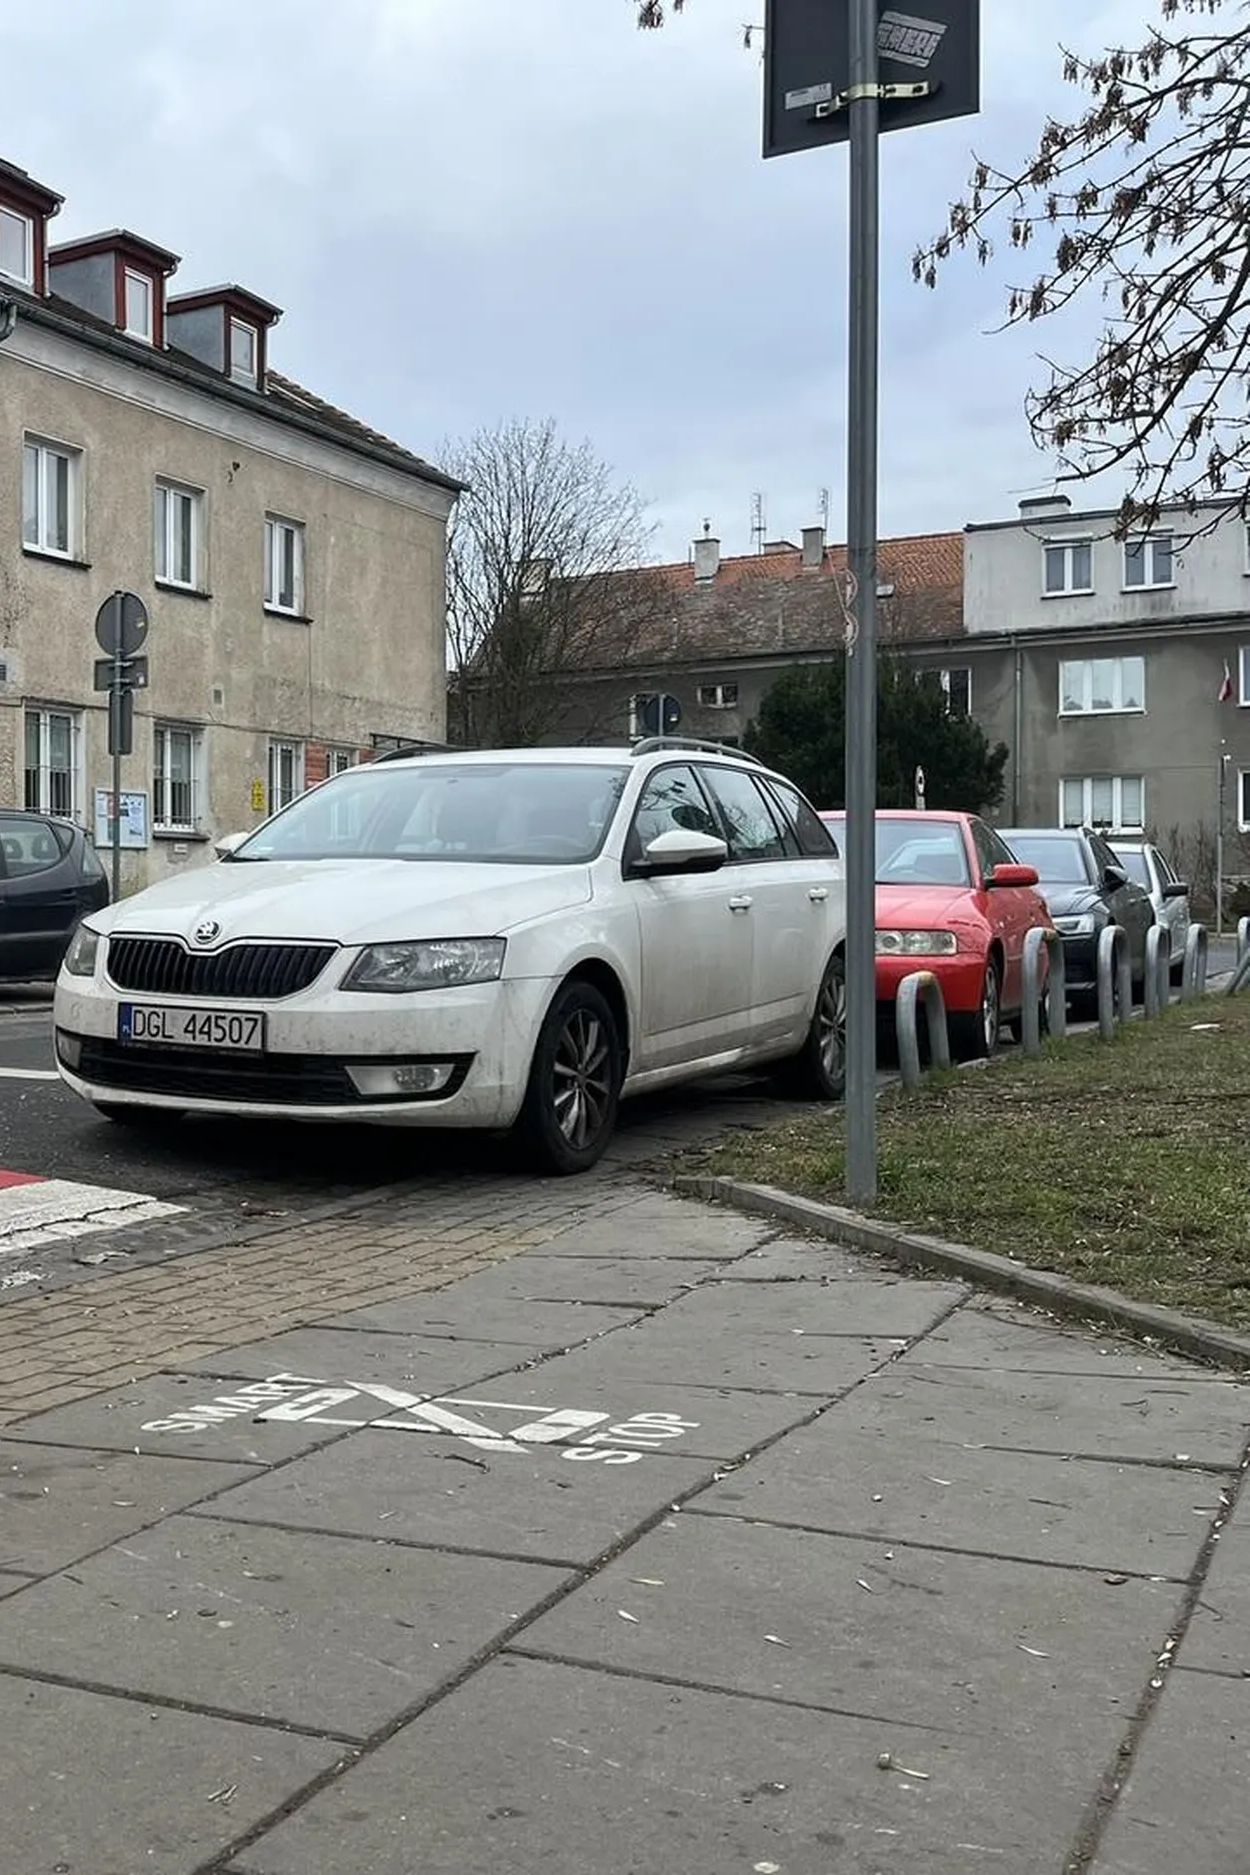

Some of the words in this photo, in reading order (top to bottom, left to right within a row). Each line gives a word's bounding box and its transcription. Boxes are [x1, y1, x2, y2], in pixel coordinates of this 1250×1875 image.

[133, 1009, 174, 1039] DGL
[183, 1013, 259, 1045] 44507
[141, 1373, 327, 1433] SMART
[561, 1413, 701, 1464] STOP
